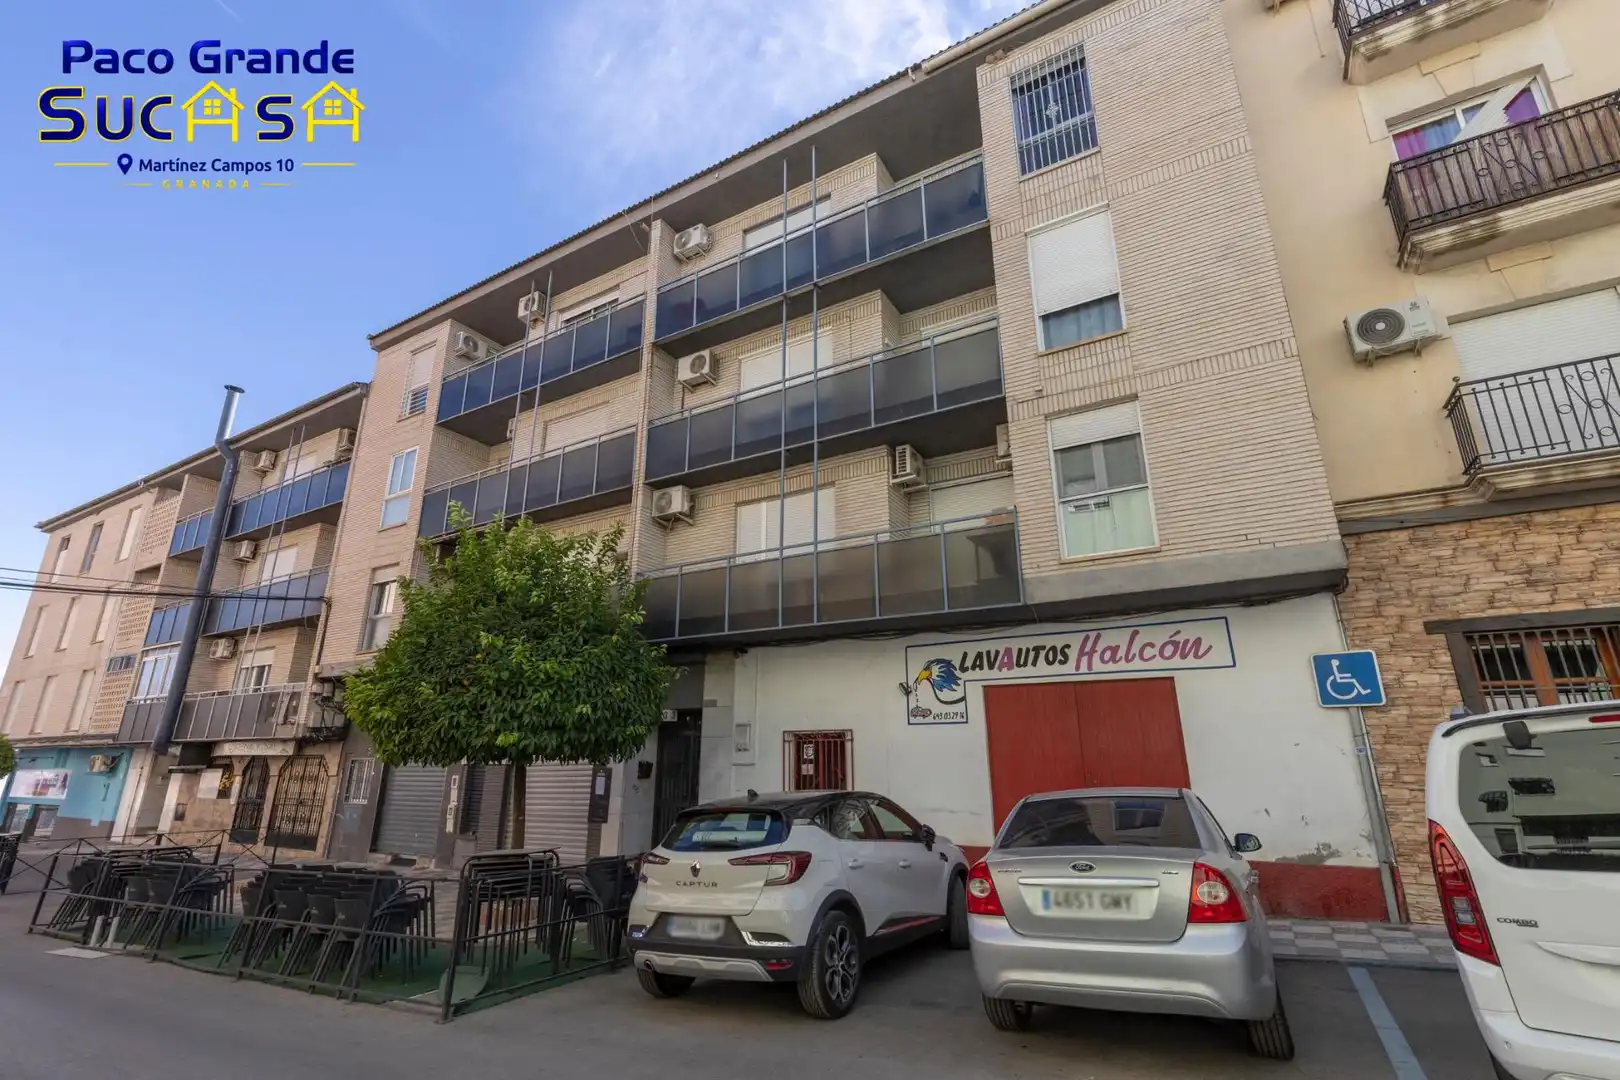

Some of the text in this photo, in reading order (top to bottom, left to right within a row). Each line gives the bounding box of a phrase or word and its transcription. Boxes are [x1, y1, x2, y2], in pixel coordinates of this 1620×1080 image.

[958, 629, 1213, 673] LAVAUTOS Halcón
[675, 880, 718, 888] CAPTUR
[1497, 917, 1539, 928] COMBO
